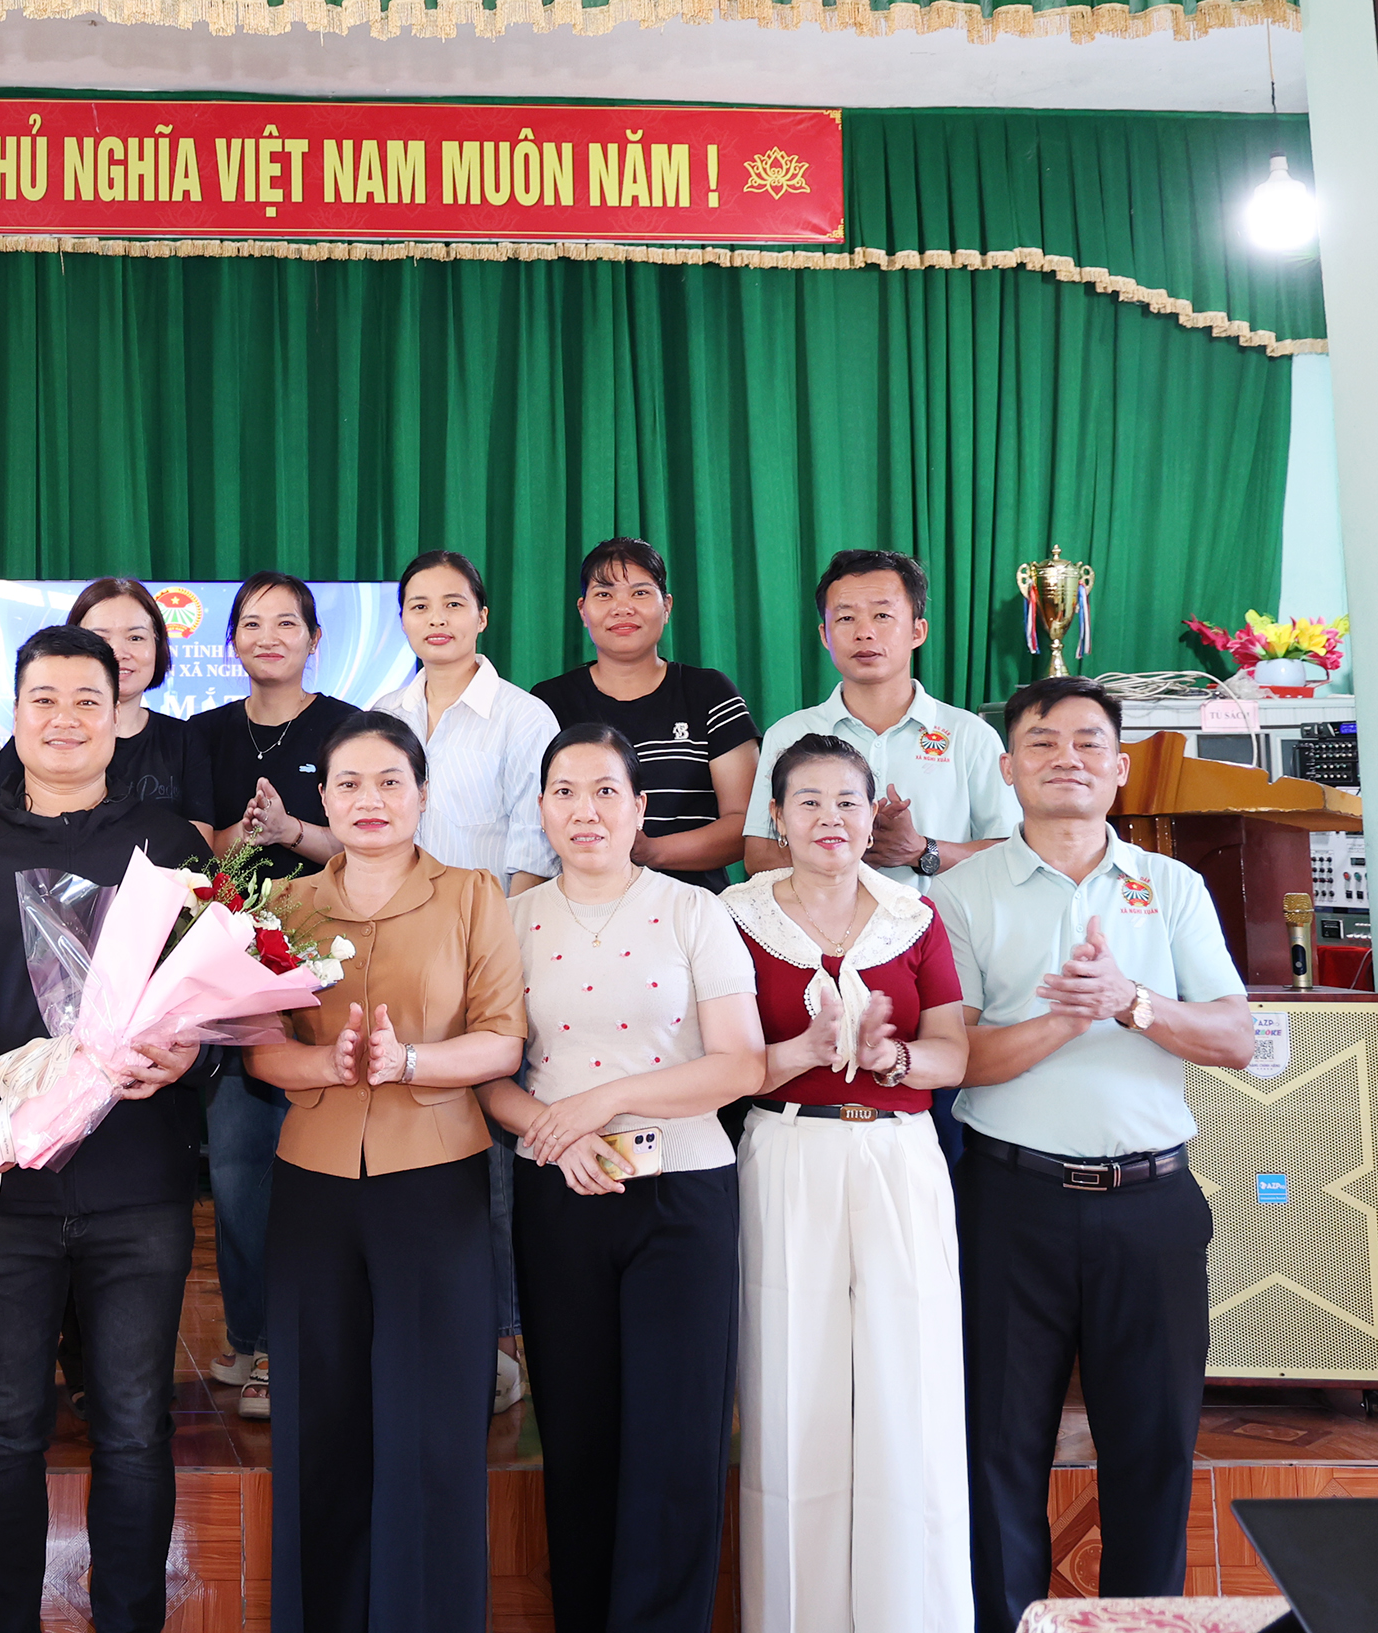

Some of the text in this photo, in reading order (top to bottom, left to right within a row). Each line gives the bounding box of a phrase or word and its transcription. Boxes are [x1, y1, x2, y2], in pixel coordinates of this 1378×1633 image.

[64, 124, 202, 202] NGHĨA
[215, 125, 309, 218] VIỆT
[323, 139, 426, 204] NAM
[441, 128, 574, 207] MUÔN
[588, 130, 691, 208] NĂM
[707, 144, 720, 208] !
[179, 661, 203, 677] XÃ
[1224, 709, 1250, 720] SÁC
